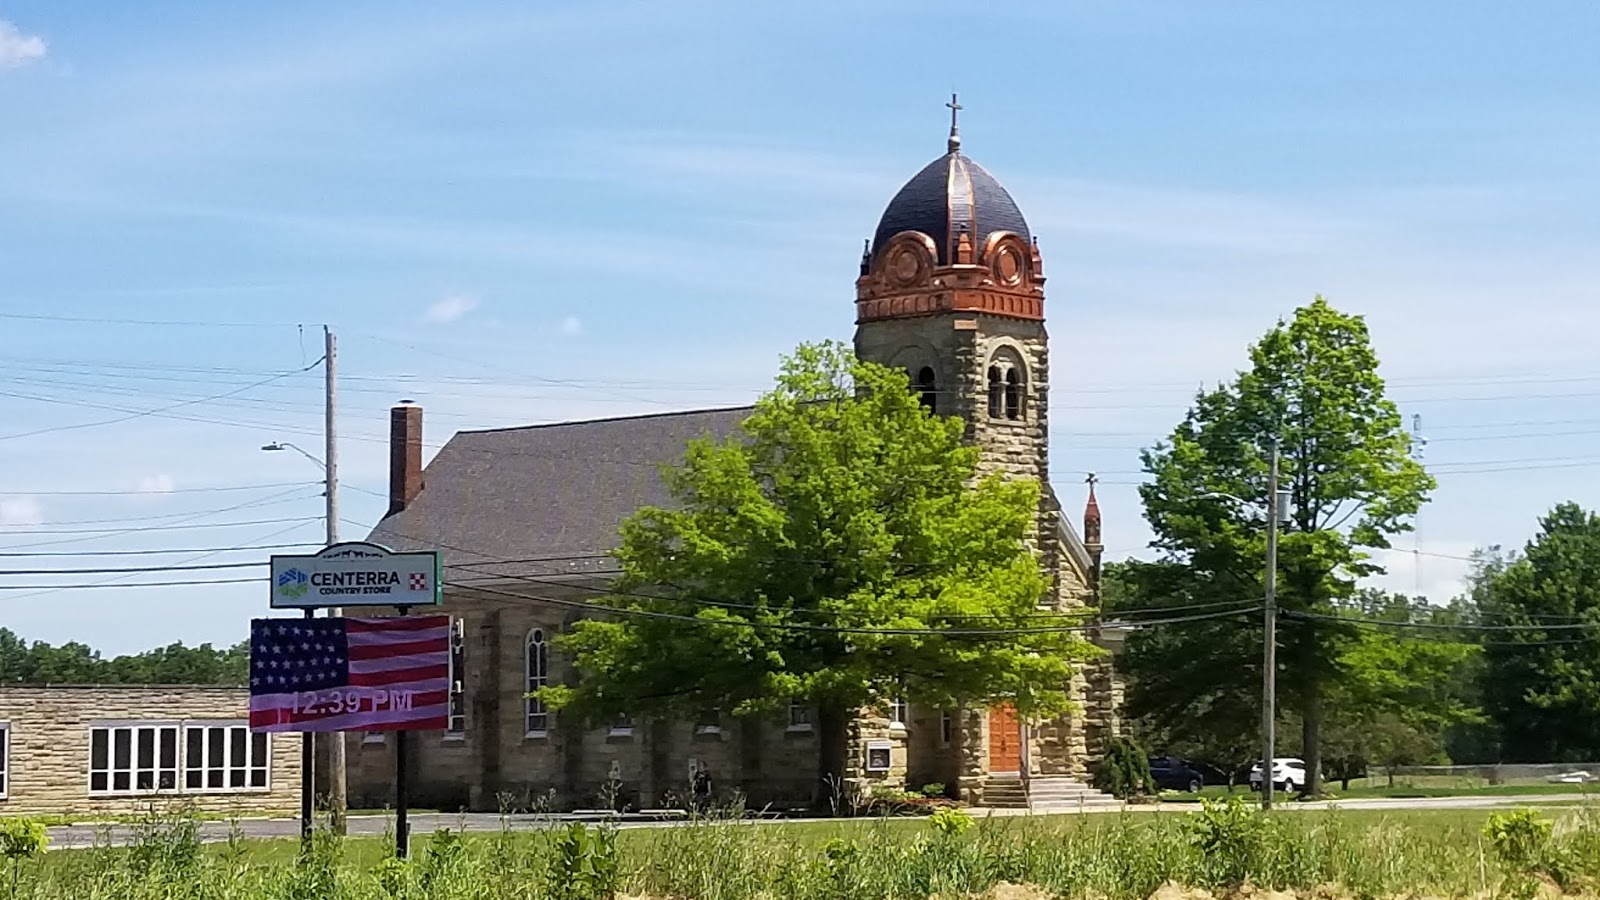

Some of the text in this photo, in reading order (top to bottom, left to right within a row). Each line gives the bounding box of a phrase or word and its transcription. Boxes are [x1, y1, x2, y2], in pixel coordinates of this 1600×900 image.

[311, 571, 400, 586] CENTERRA
[319, 586, 392, 595] COUNTRY STORE
[291, 689, 412, 714] 12:39 PM
